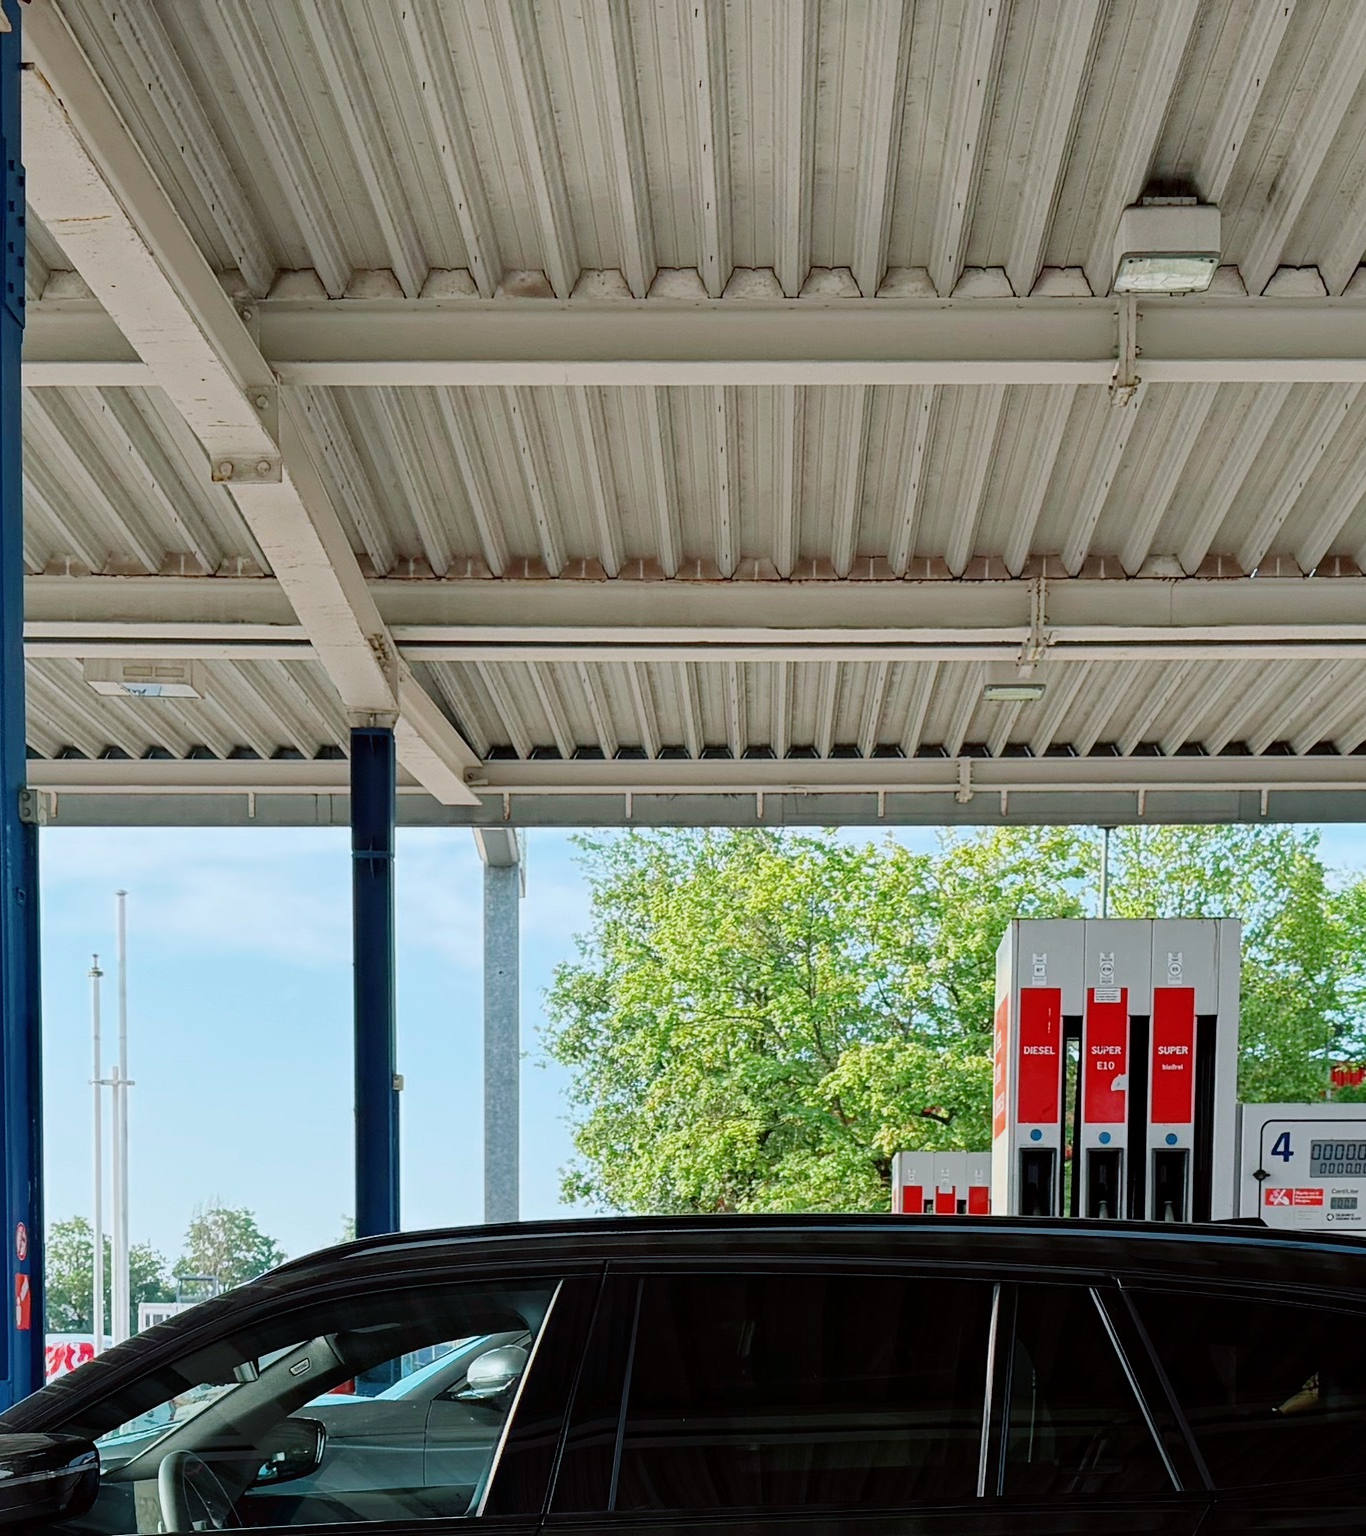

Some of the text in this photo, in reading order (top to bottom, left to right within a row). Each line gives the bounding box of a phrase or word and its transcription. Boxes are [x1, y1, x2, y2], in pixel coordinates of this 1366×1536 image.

[1023, 1046, 1056, 1055] DIESEL
[1091, 1046, 1122, 1055] SUPER
[1157, 1046, 1189, 1055] SUPER
[1096, 1061, 1115, 1070] E10
[1271, 1132, 1294, 1162] 4
